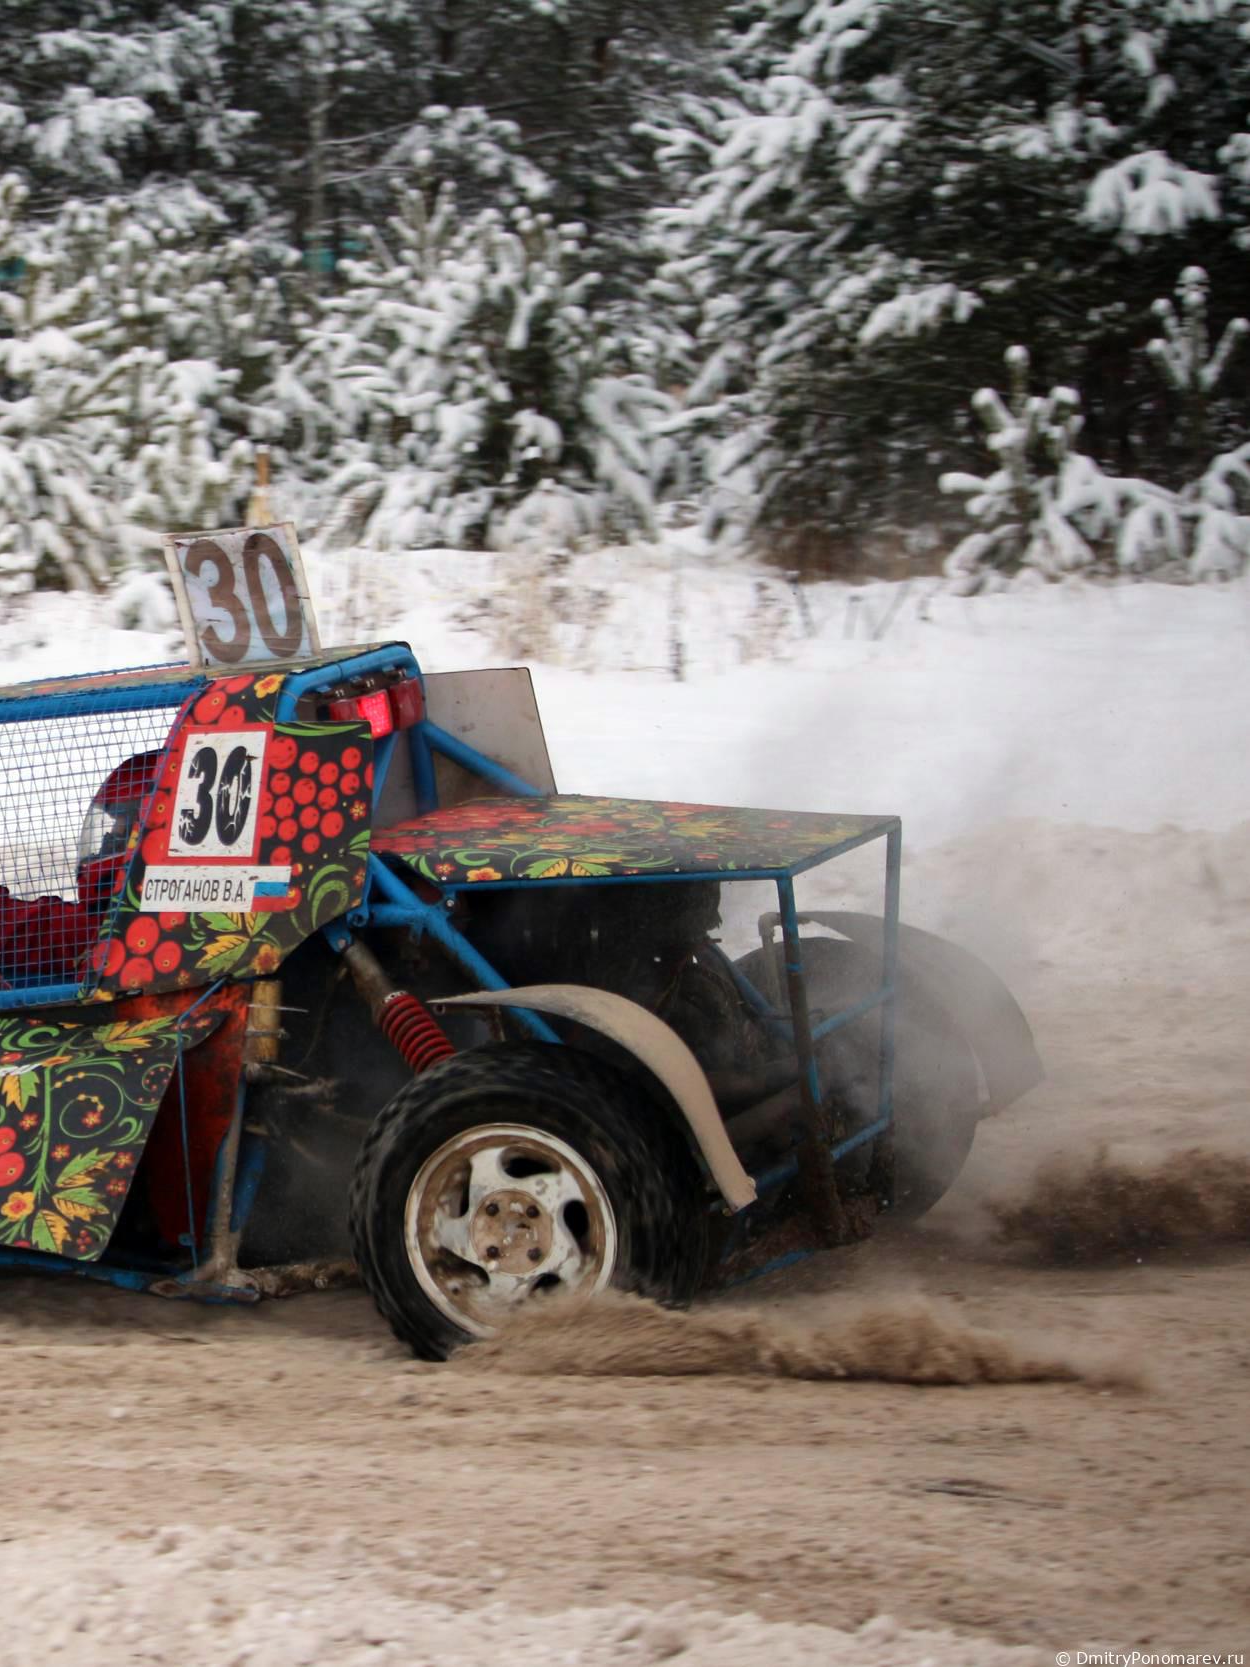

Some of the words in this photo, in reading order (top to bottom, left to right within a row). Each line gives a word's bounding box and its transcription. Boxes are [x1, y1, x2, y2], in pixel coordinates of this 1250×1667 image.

[185, 533, 302, 664] 30
[178, 746, 252, 846] 30
[145, 879, 218, 902] СТРОГАНОВ
[222, 880, 246, 902] В.А.
